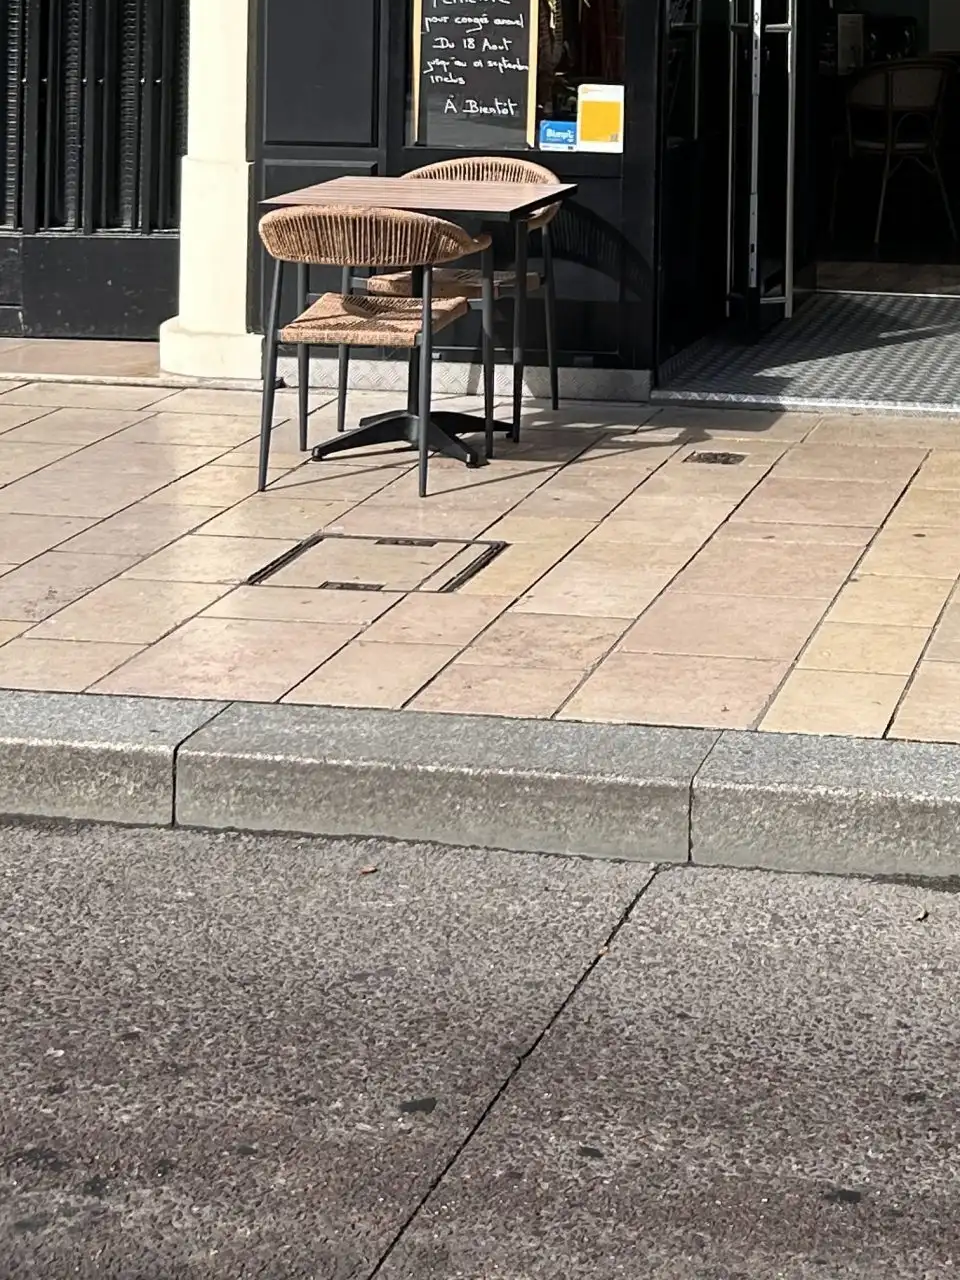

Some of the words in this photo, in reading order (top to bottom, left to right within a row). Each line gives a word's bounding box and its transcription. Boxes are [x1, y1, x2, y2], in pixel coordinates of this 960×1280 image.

[425, 15, 449, 32] pour
[432, 37, 455, 49] Du
[463, 37, 475, 49] 18
